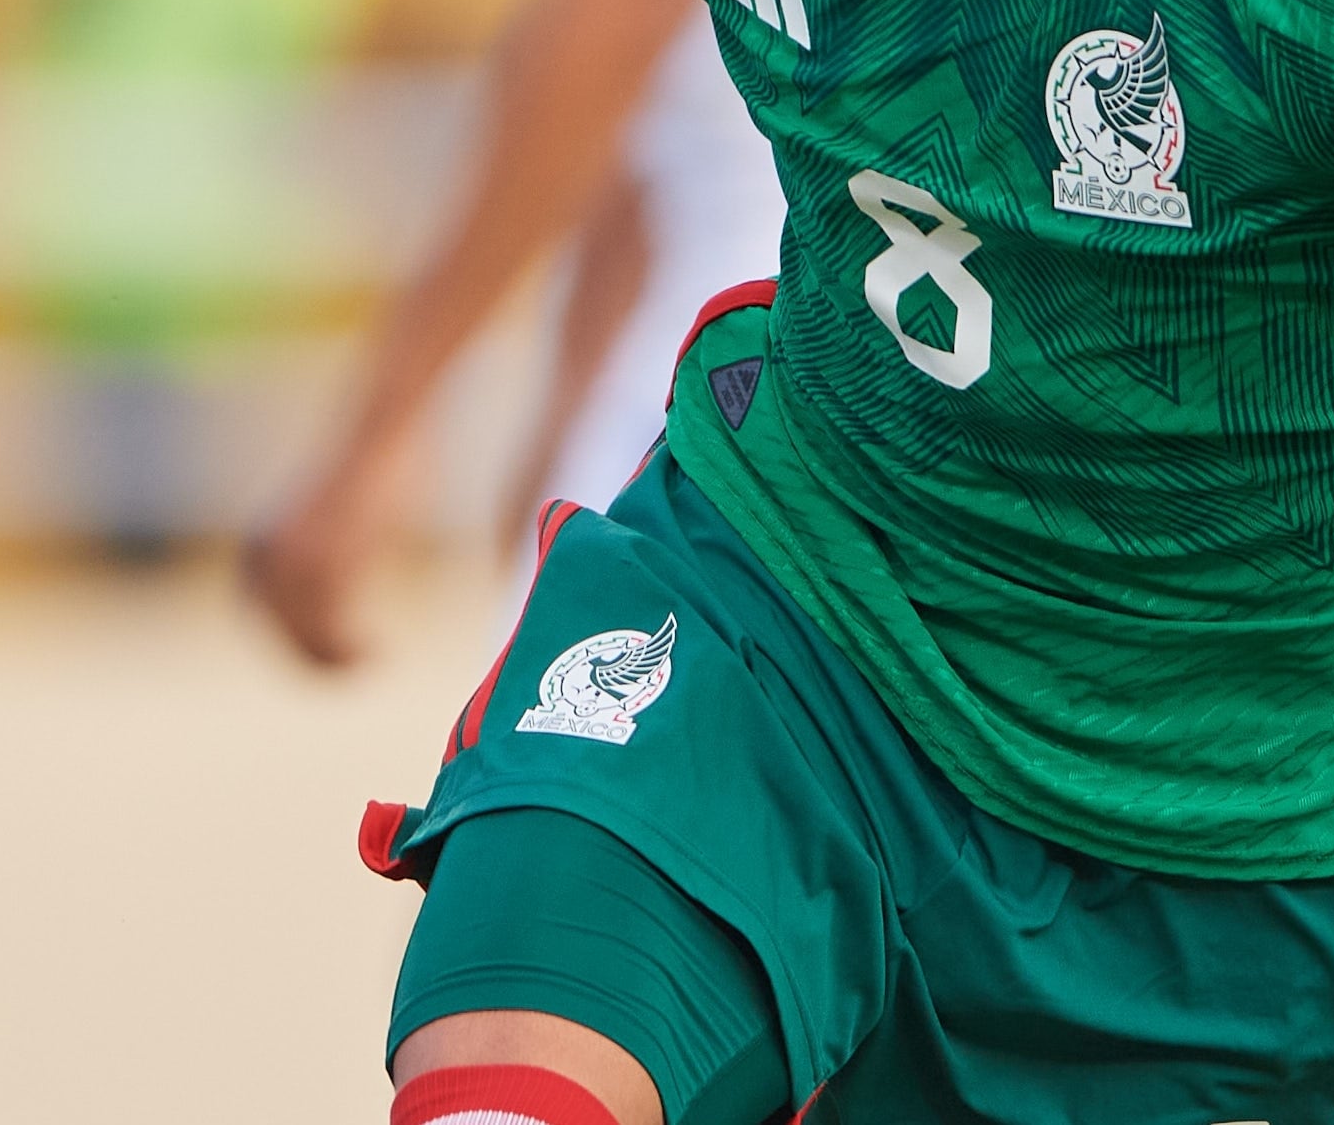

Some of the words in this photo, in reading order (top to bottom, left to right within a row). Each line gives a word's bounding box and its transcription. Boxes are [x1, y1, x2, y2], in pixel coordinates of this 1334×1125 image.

[1057, 176, 1186, 219] MÉXICO
[848, 168, 994, 390] 8
[522, 713, 628, 739] MÉXICO
